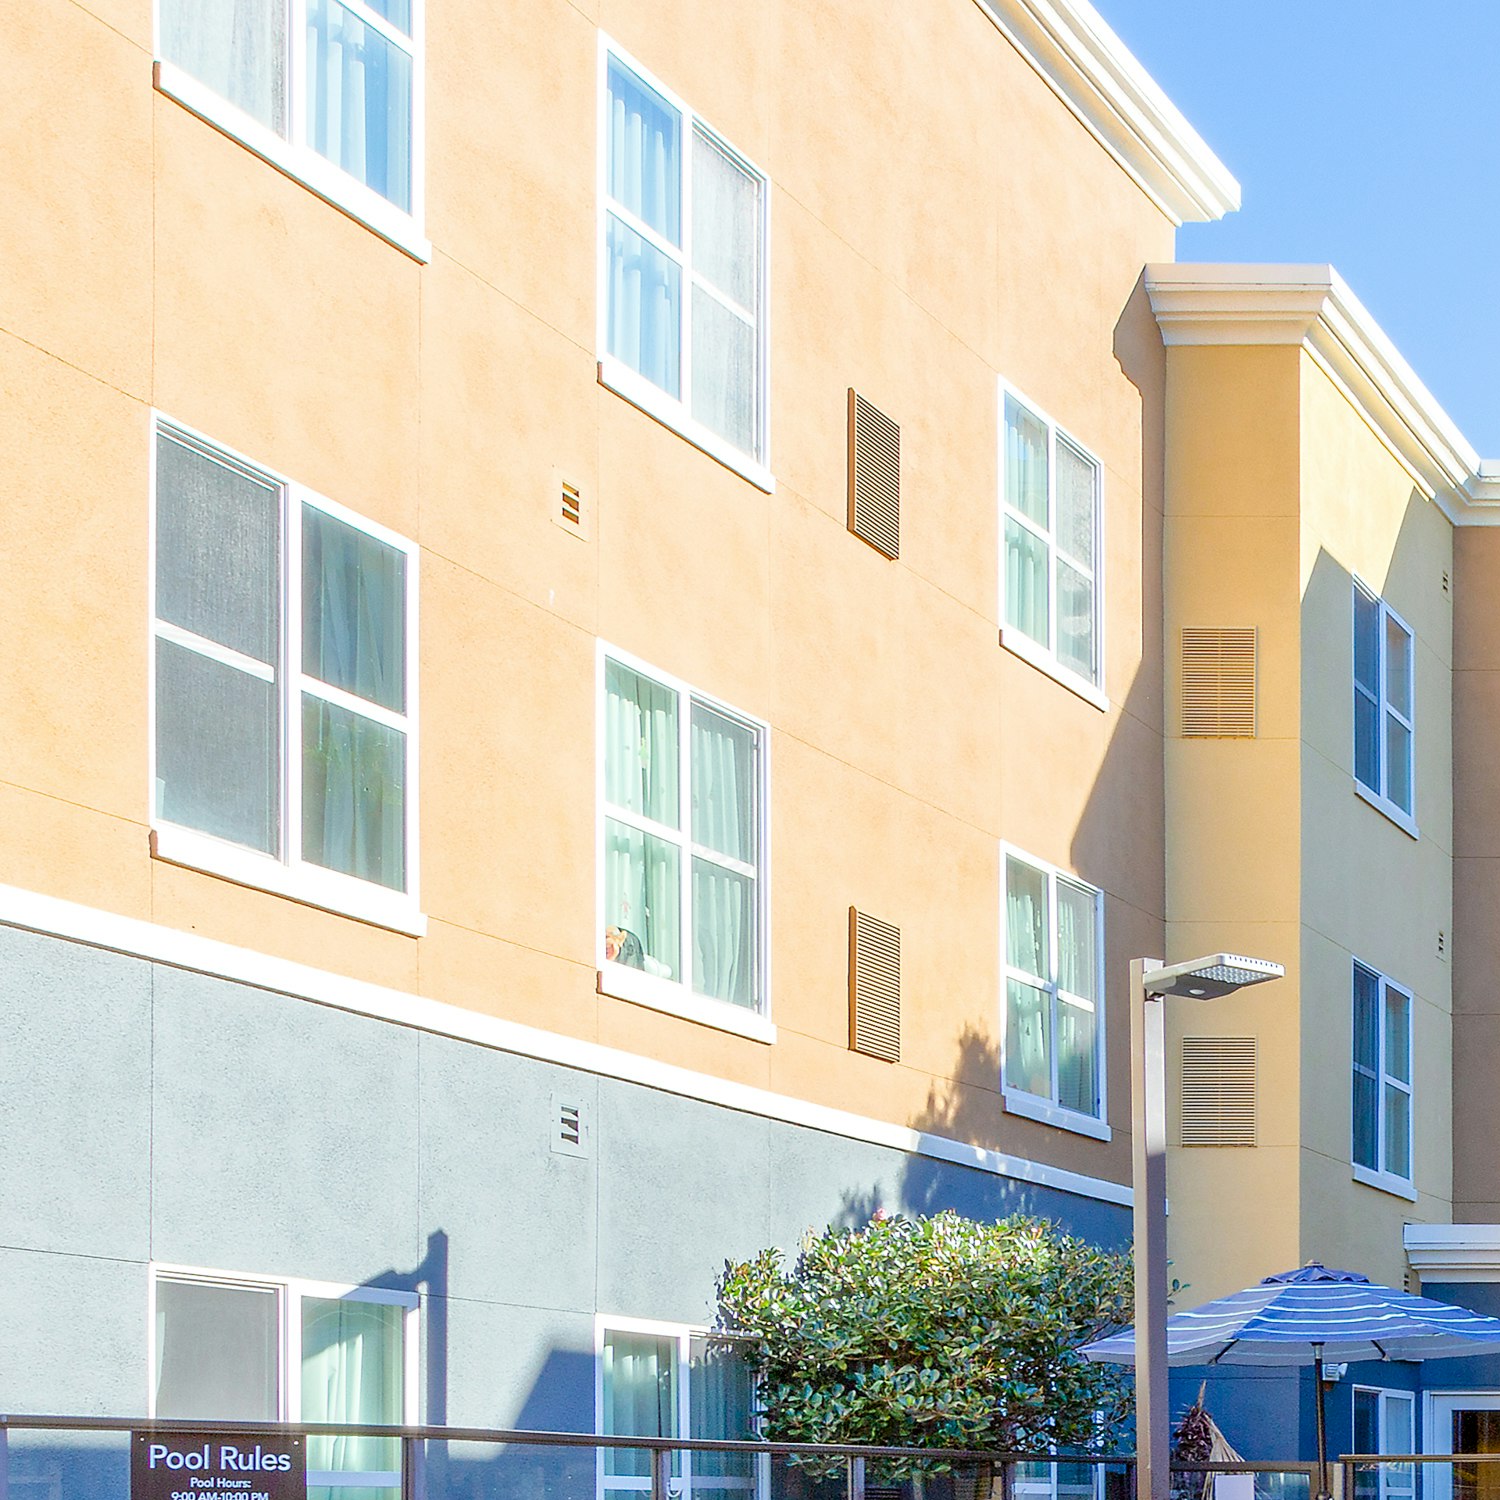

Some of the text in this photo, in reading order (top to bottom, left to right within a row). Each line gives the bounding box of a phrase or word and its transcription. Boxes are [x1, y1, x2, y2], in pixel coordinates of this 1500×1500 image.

[149, 1444, 291, 1471] Pool Rules
[190, 1477, 252, 1488] Pool Hours:
